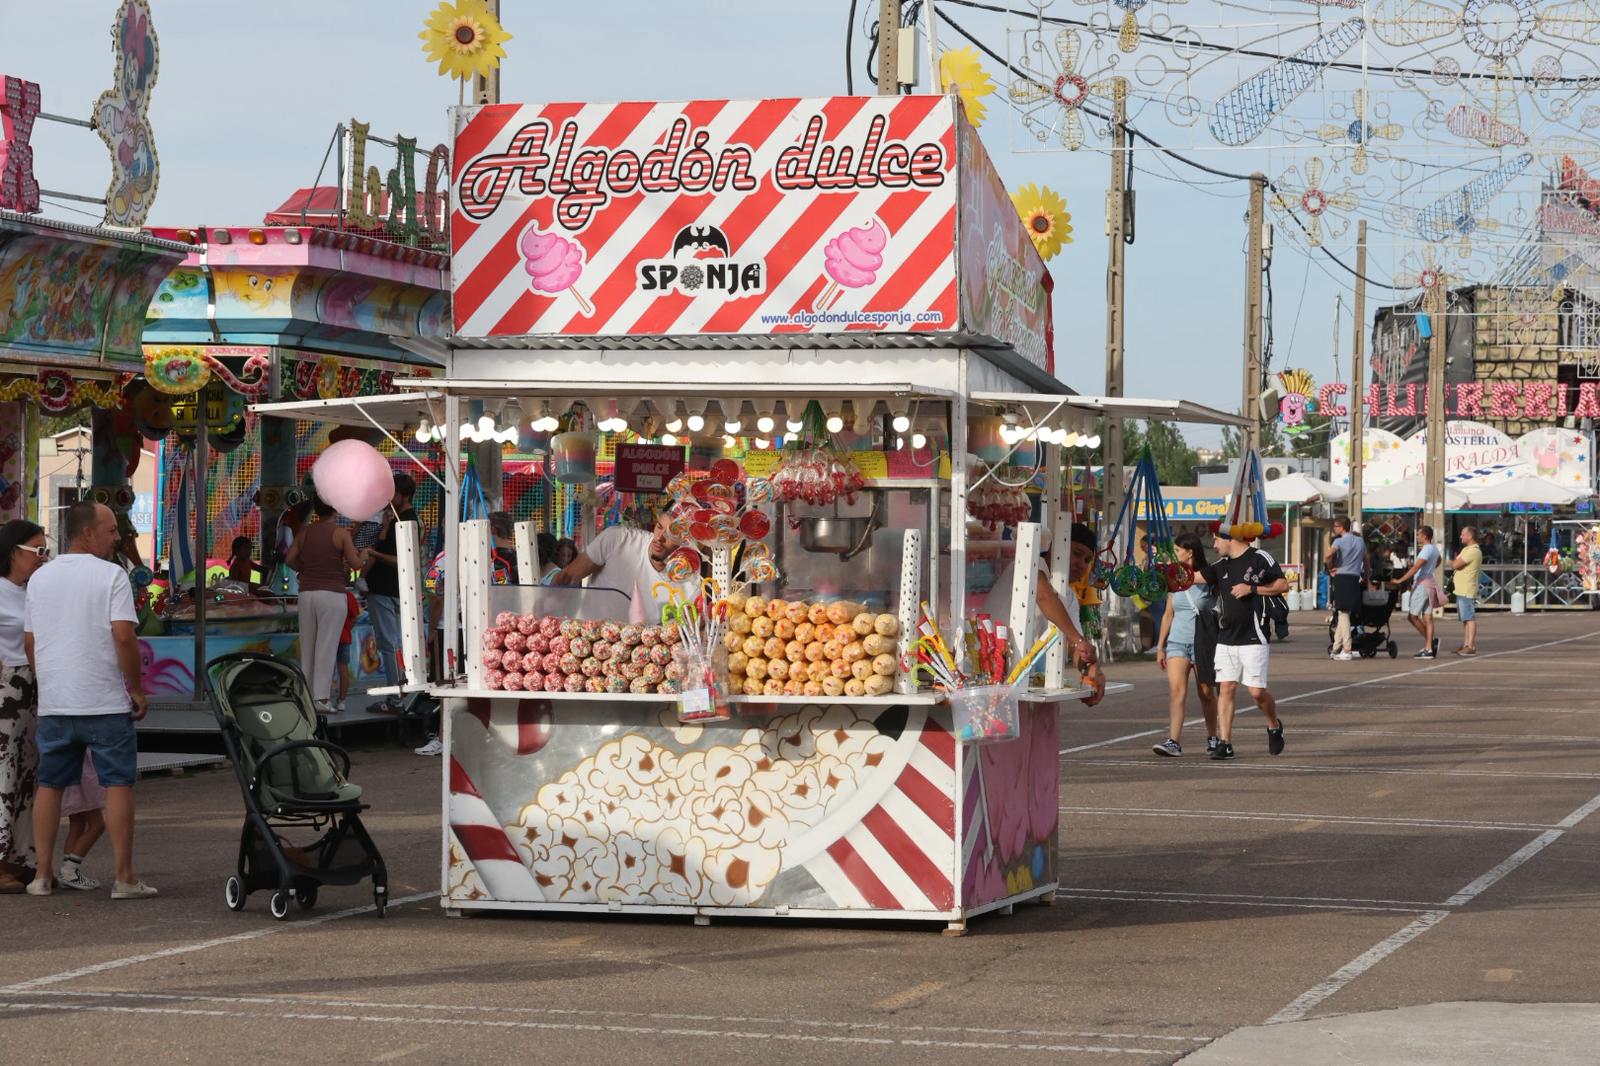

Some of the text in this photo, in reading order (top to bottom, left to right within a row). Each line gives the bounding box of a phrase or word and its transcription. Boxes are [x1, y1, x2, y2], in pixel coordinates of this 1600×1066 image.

[459, 113, 945, 231] Algodón dulce
[761, 310, 942, 327] www.algodondulcesponja.com
[1446, 444, 1520, 472] IRALDA
[1177, 501, 1193, 515] La
